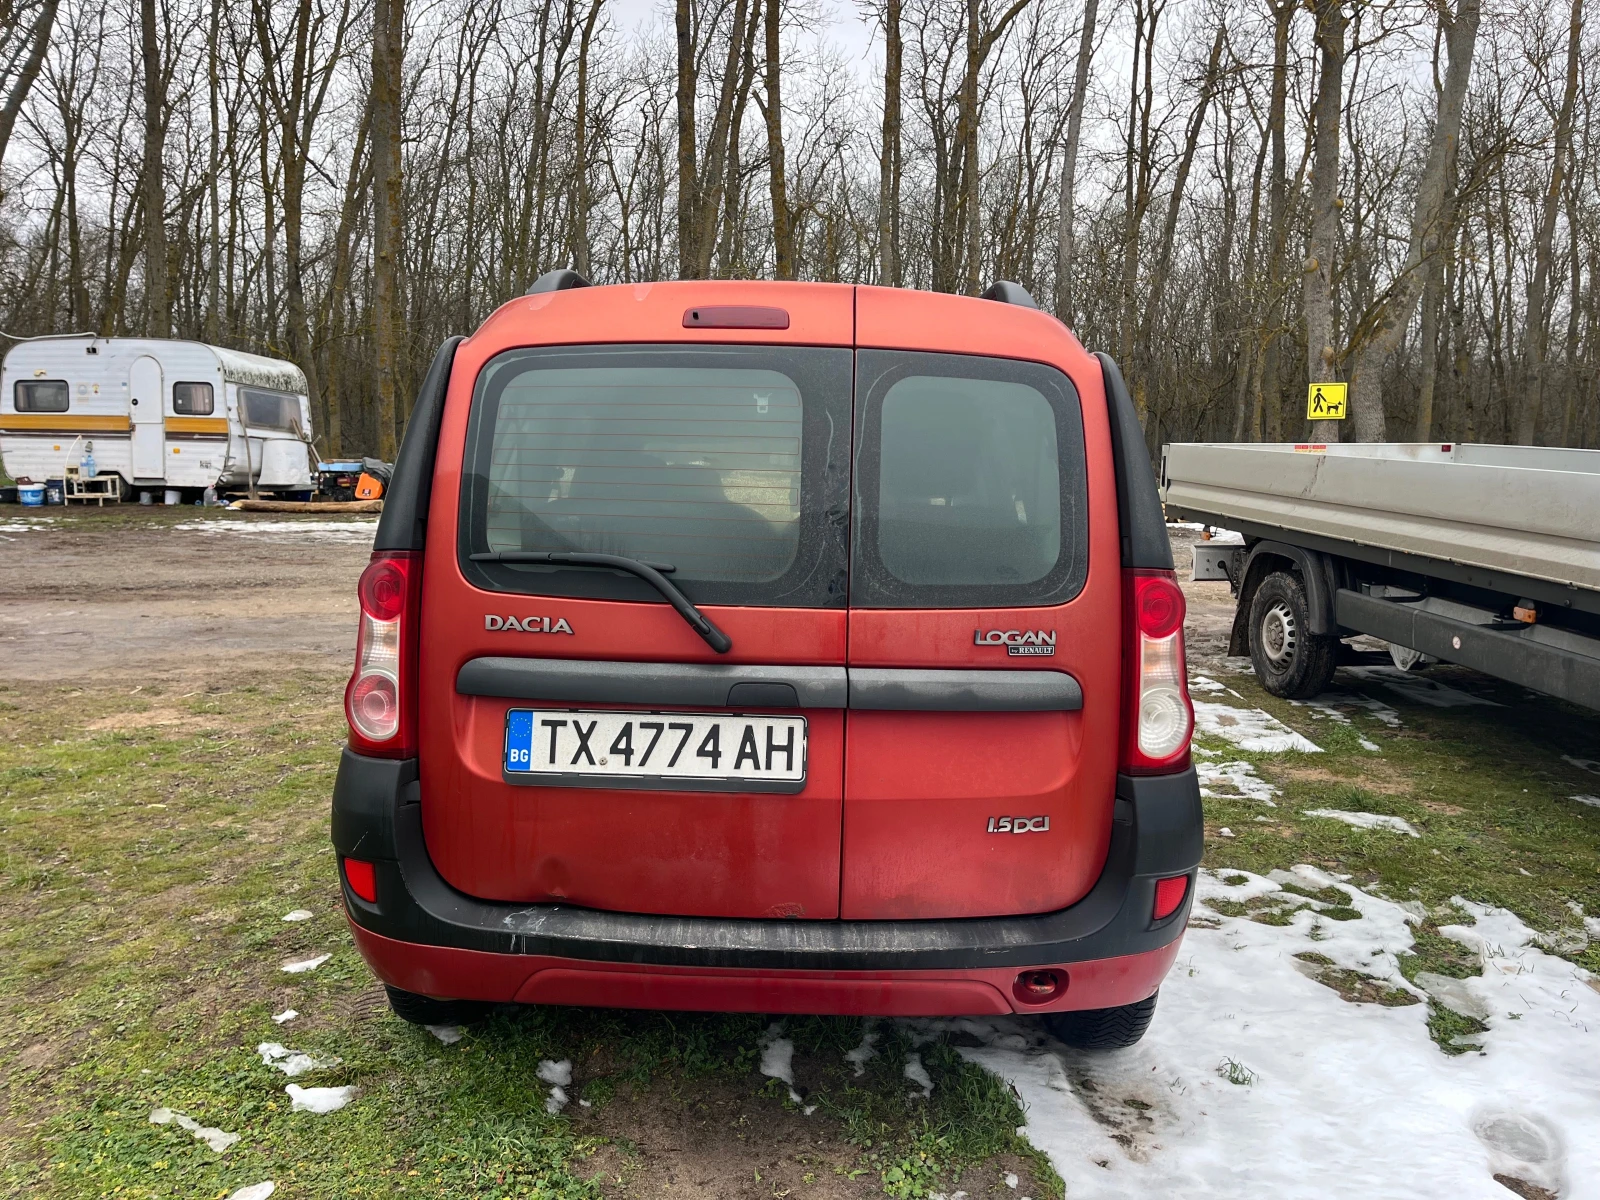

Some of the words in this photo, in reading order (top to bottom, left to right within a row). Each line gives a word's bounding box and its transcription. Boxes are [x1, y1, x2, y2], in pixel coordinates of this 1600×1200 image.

[484, 614, 574, 635] DACIA
[974, 629, 1057, 646] LOGAN
[541, 719, 598, 766] TX
[609, 721, 722, 769] 4774
[733, 724, 795, 771] AH
[510, 748, 529, 763] BG
